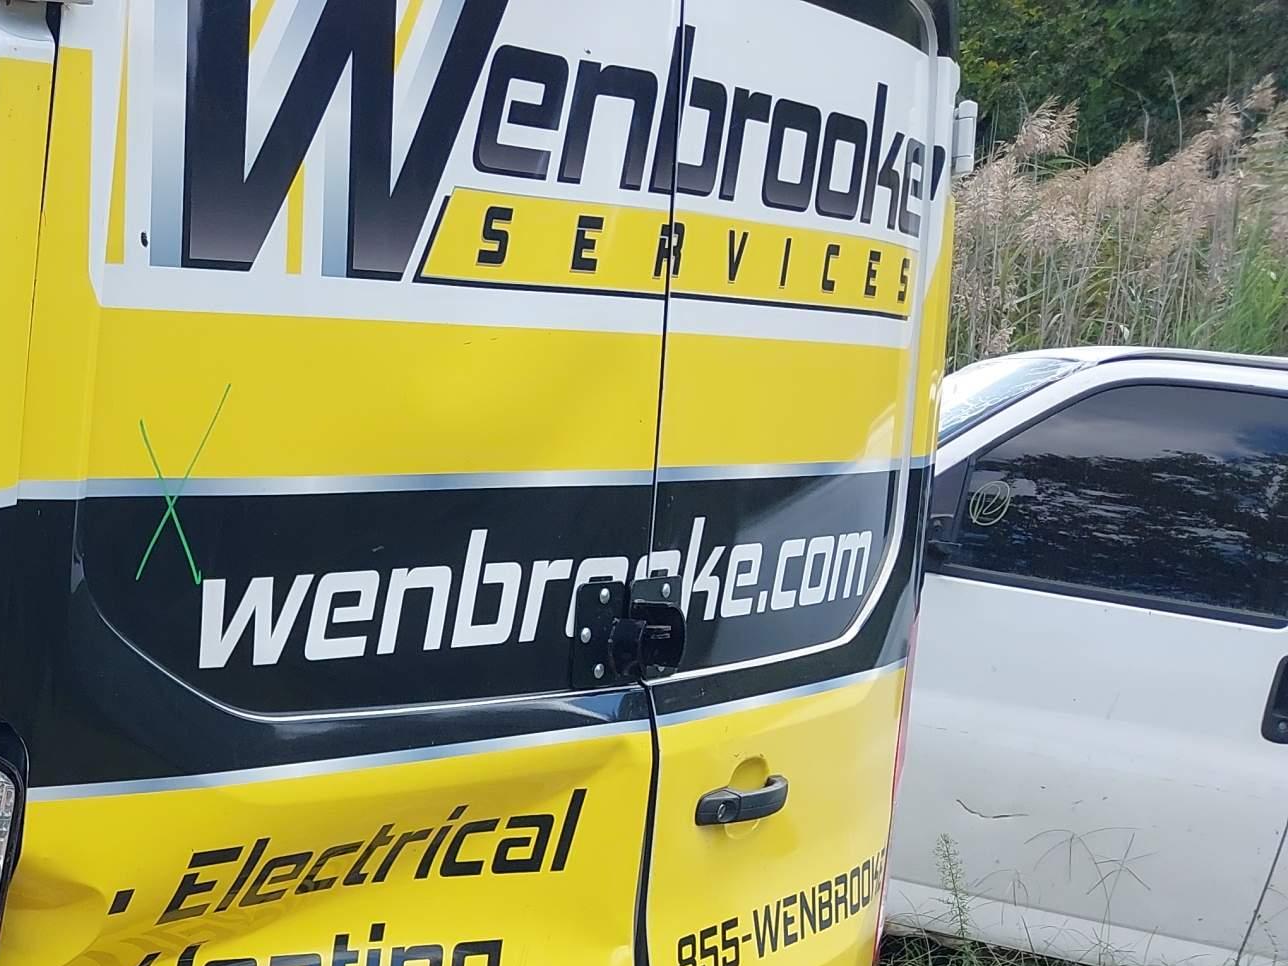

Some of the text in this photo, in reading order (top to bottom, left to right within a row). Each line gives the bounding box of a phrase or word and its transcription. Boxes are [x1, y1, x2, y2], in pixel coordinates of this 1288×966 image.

[149, 0, 946, 282] Wenbrooke
[475, 206, 911, 304] SERVICES
[155, 788, 587, 926] Electrical
